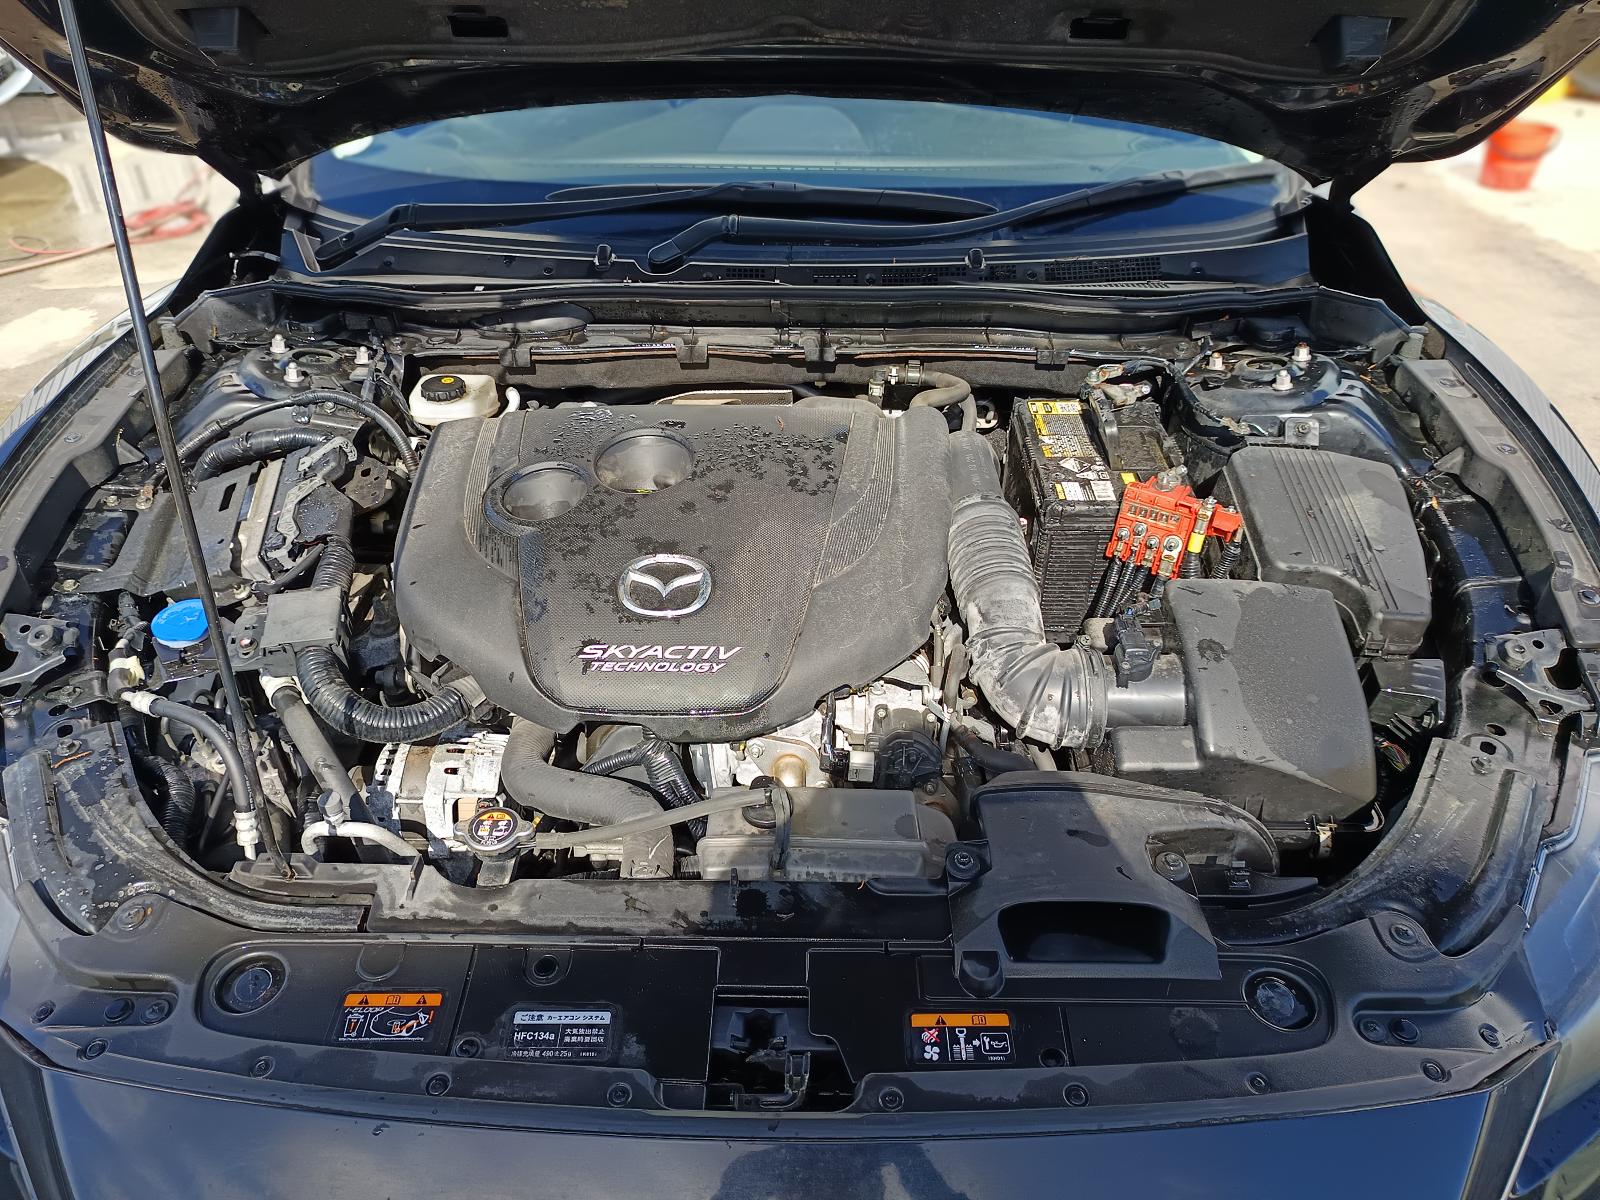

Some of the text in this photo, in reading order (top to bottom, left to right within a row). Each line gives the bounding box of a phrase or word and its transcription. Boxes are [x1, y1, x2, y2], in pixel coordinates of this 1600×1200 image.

[578, 644, 744, 660] SKYACTIV
[589, 661, 727, 673] TECHNOLOGY
[520, 1013, 545, 1022] ご注意
[514, 1031, 555, 1041] HFC134a
